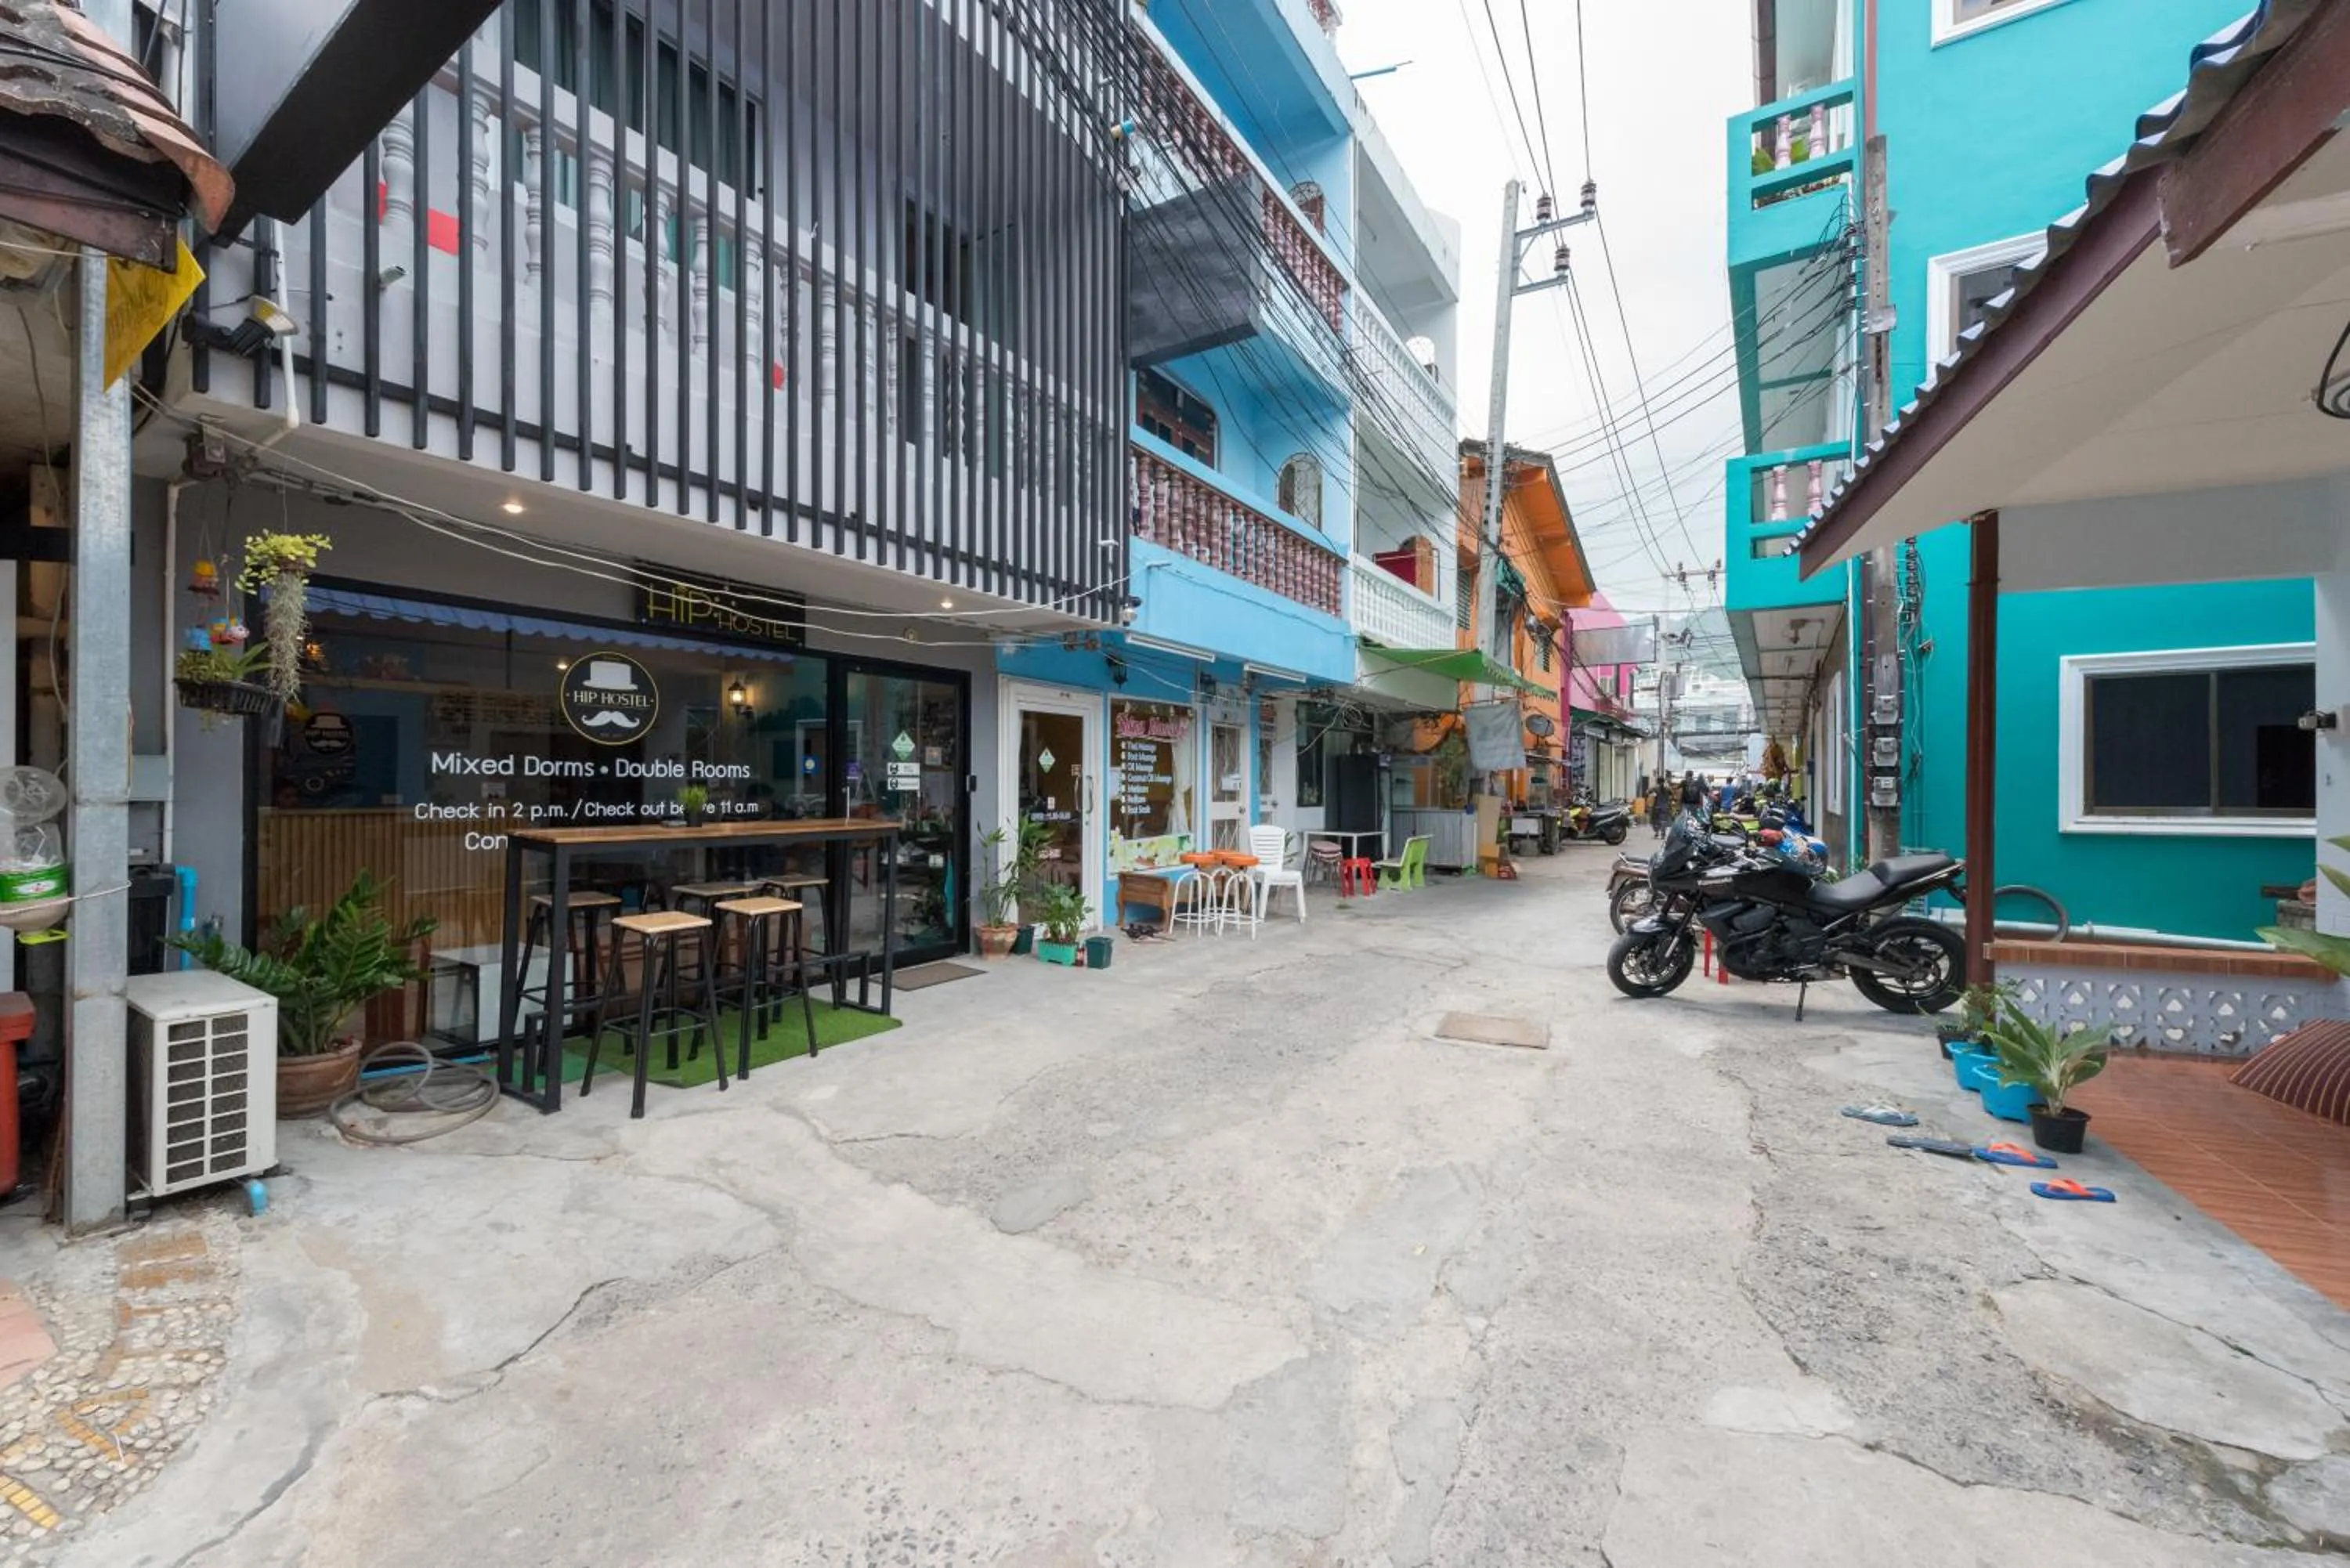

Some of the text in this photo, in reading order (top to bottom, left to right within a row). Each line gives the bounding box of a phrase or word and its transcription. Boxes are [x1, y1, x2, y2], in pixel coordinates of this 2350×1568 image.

[648, 583, 797, 641] HIP HOSTEL
[573, 690, 650, 707] HIP HOSTEL
[432, 751, 750, 779] Mixed Dorms Double Rooms
[414, 802, 480, 819] Check
[488, 803, 505, 818] in
[513, 802, 523, 818] 2
[640, 801, 665, 816] out
[465, 831, 509, 851] Con
